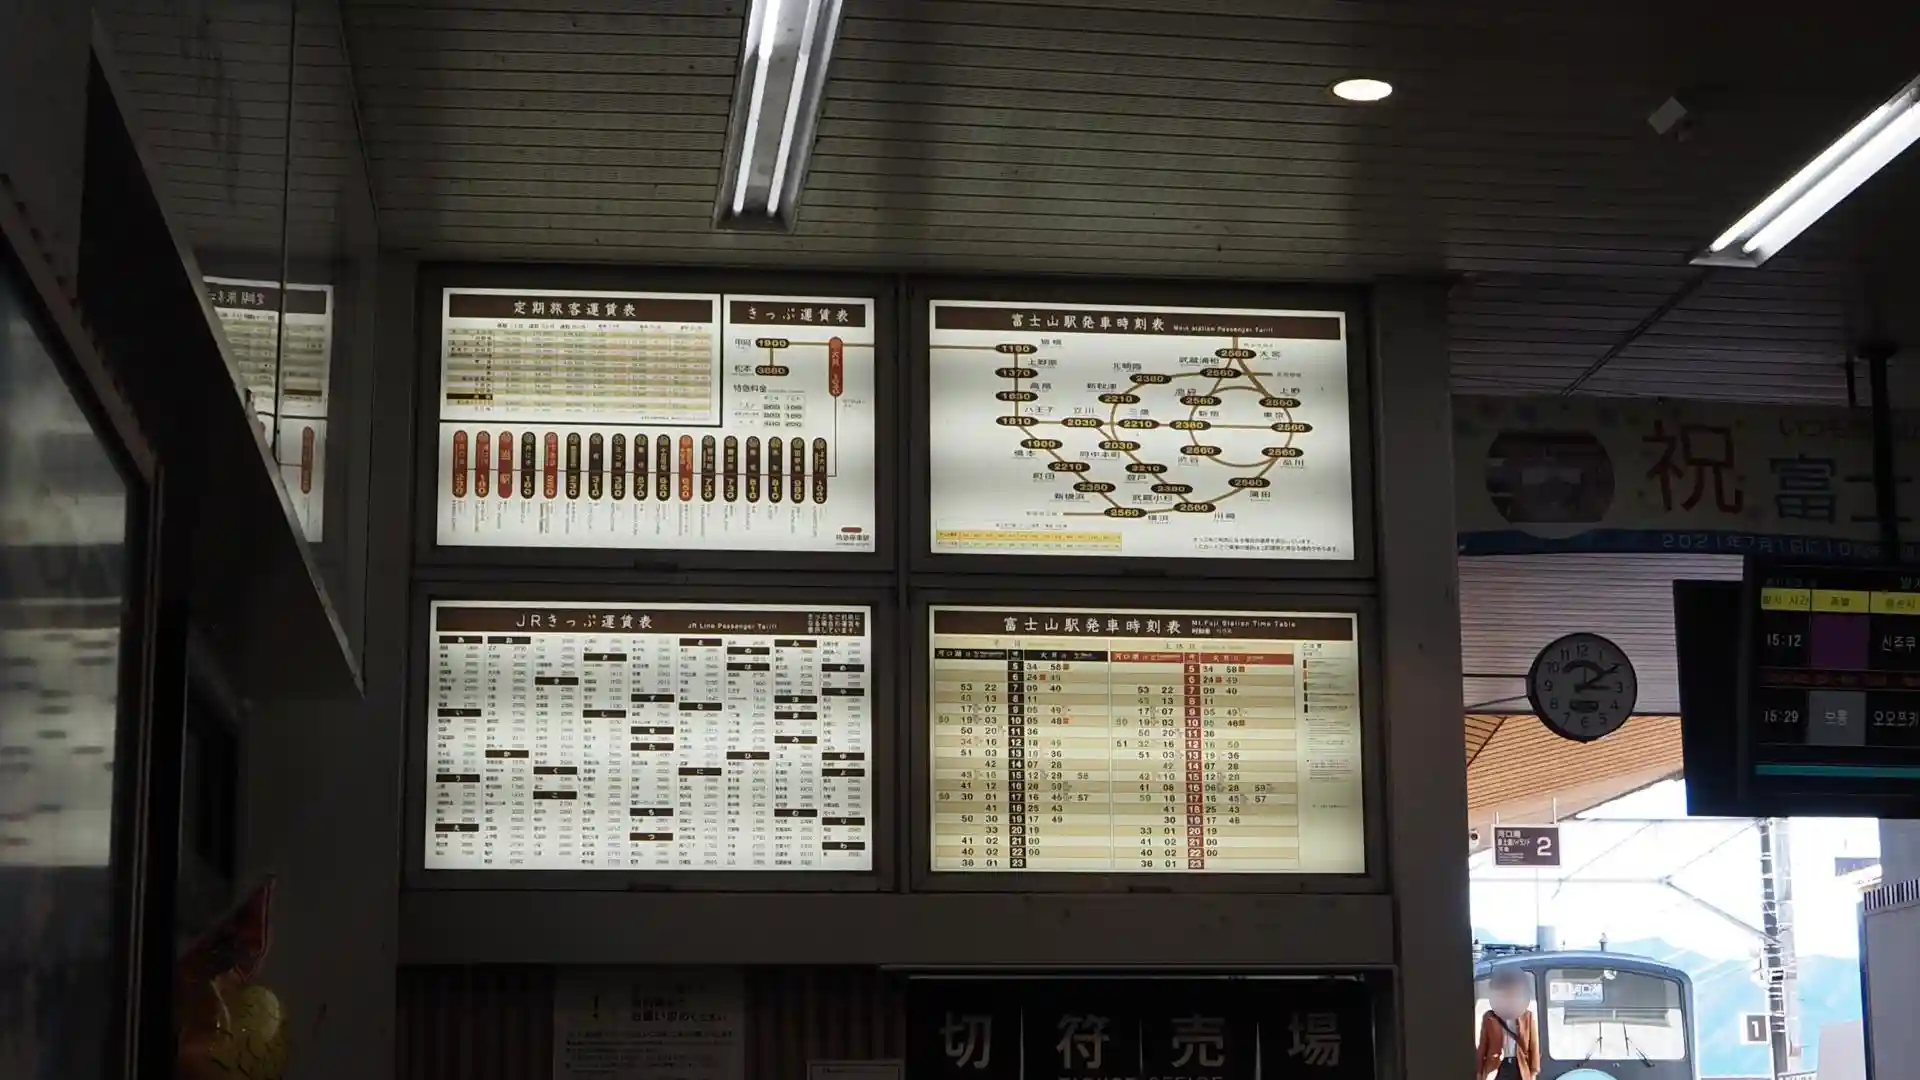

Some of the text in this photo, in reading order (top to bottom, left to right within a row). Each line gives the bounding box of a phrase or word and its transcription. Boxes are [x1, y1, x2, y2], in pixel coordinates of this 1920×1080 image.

[514, 301, 636, 316] 定期旅客運賃表
[748, 307, 849, 322] きっぷ運賃表
[1012, 313, 1165, 331] 富士山駅発車時刻表
[1642, 419, 1744, 515] 祝
[516, 614, 652, 628] JRきっぷ運賃表
[1004, 617, 1182, 635] 富士山駅発車時刻表
[1767, 633, 1802, 647] 15:12
[1561, 648, 1569, 660] 11
[1577, 644, 1588, 657] 12
[1547, 662, 1559, 674] 10
[1545, 680, 1552, 691] 9
[1615, 682, 1623, 693] 3
[1763, 709, 1799, 724] 15:29
[1187, 741, 1198, 749] 12
[1537, 837, 1552, 856] 2
[1751, 1021, 1760, 1037] 1
[939, 1013, 1341, 1069] 切符売場
